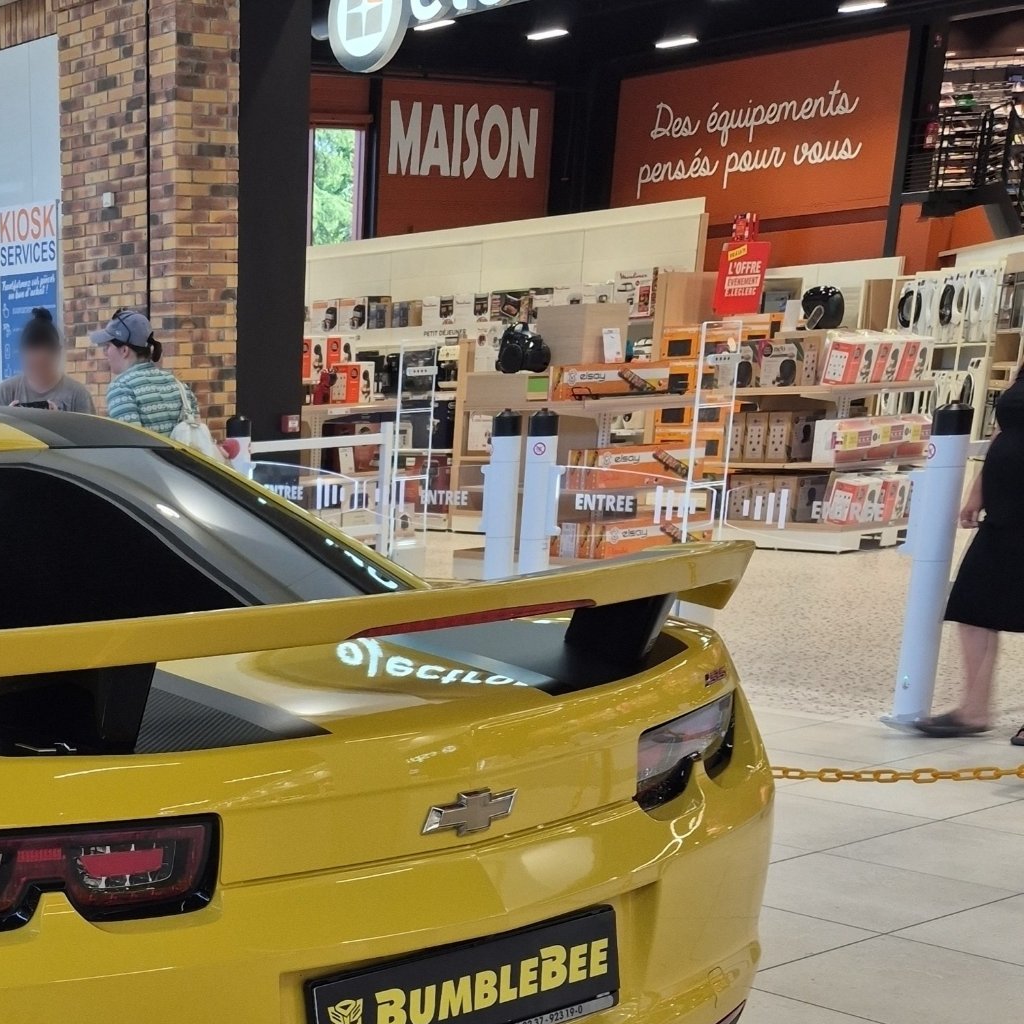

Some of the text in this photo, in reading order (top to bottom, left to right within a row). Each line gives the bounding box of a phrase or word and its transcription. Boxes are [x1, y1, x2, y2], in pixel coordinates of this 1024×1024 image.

[649, 80, 860, 147] Des équipements
[388, 100, 539, 180] MAISON
[636, 137, 863, 199] pensés pour vous
[0, 204, 55, 243] KIOSK
[0, 240, 56, 267] SERVICES
[728, 260, 762, 275] L'OFFRE
[724, 287, 756, 297] E.LECLERC
[420, 489, 468, 506] ENTREE
[575, 493, 635, 513] ENTREE
